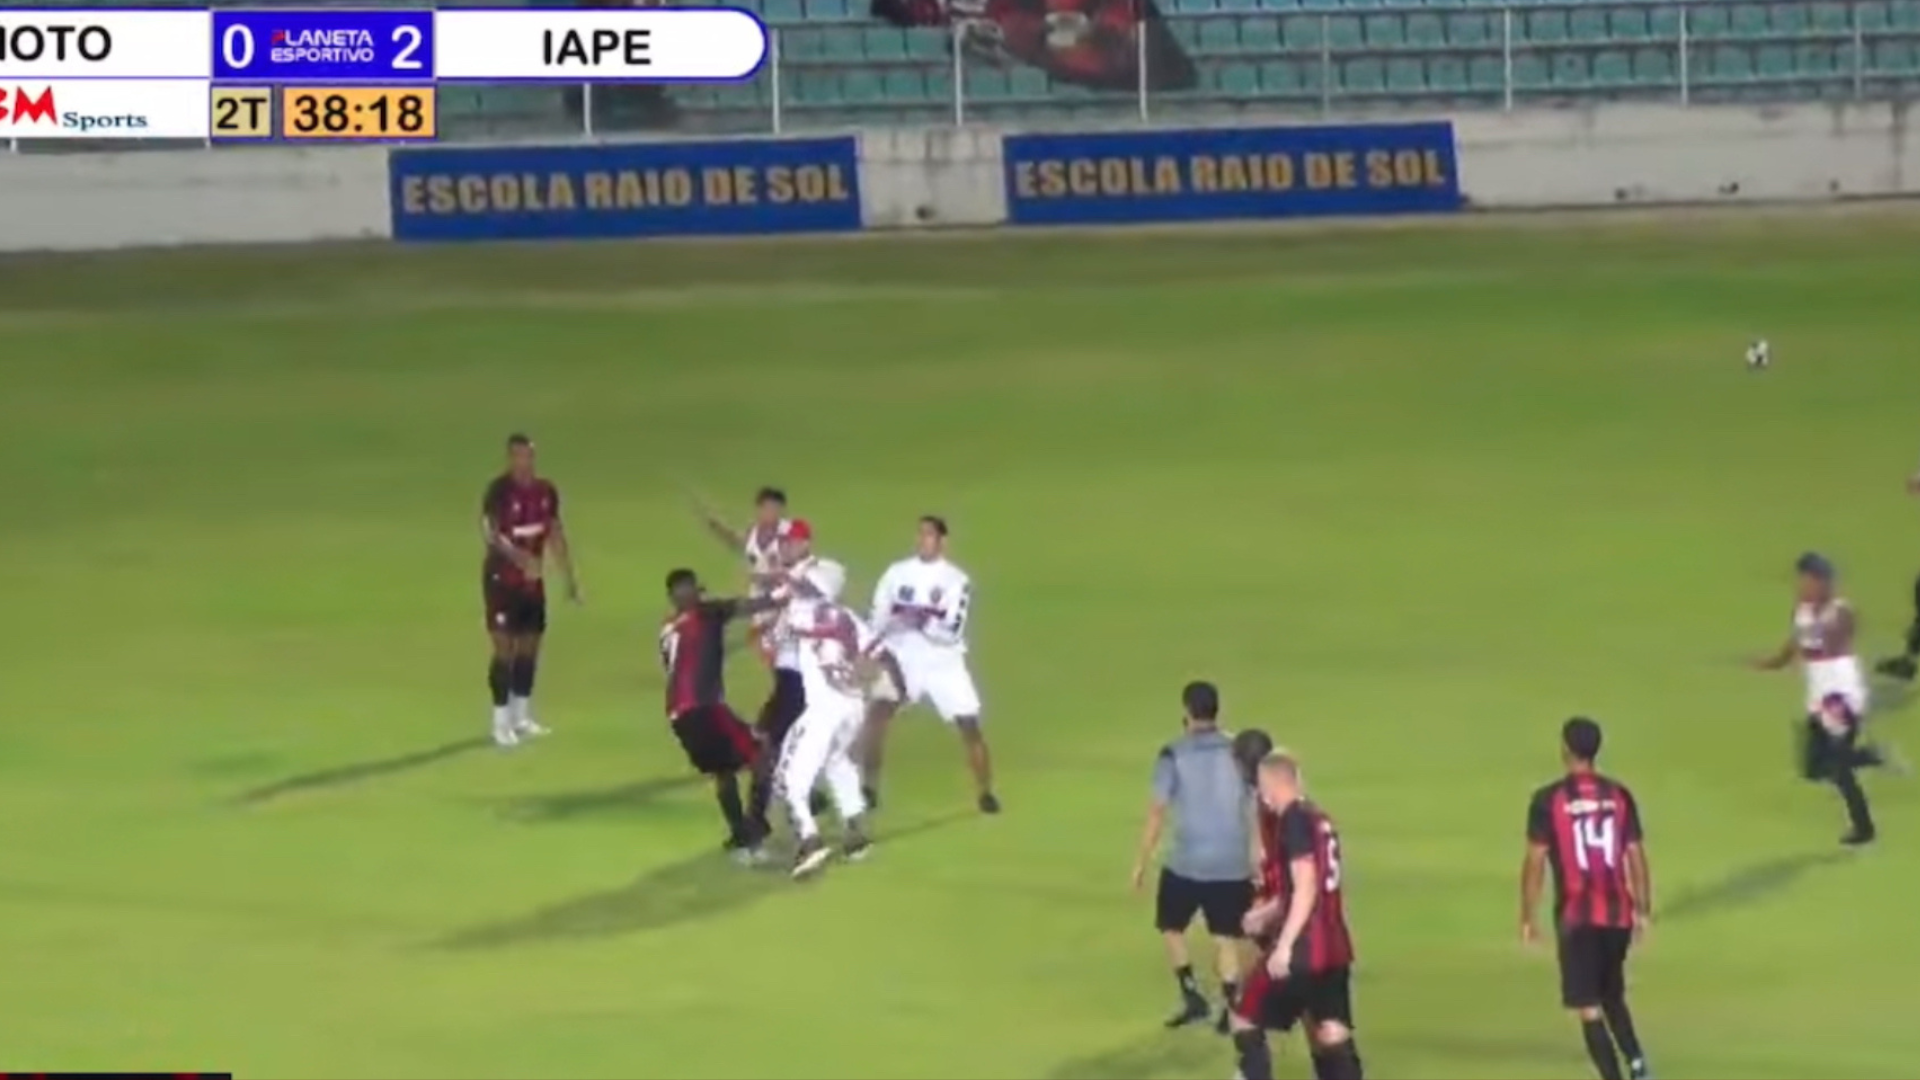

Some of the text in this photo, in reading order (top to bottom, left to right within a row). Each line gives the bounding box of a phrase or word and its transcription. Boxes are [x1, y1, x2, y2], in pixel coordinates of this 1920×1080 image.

[401, 163, 849, 214] ESCOLA RAIO DE SOL
[1015, 148, 1445, 198] ESCOLA RAIO DE SOL
[1324, 837, 1341, 893] 5
[1572, 815, 1616, 871] 14
